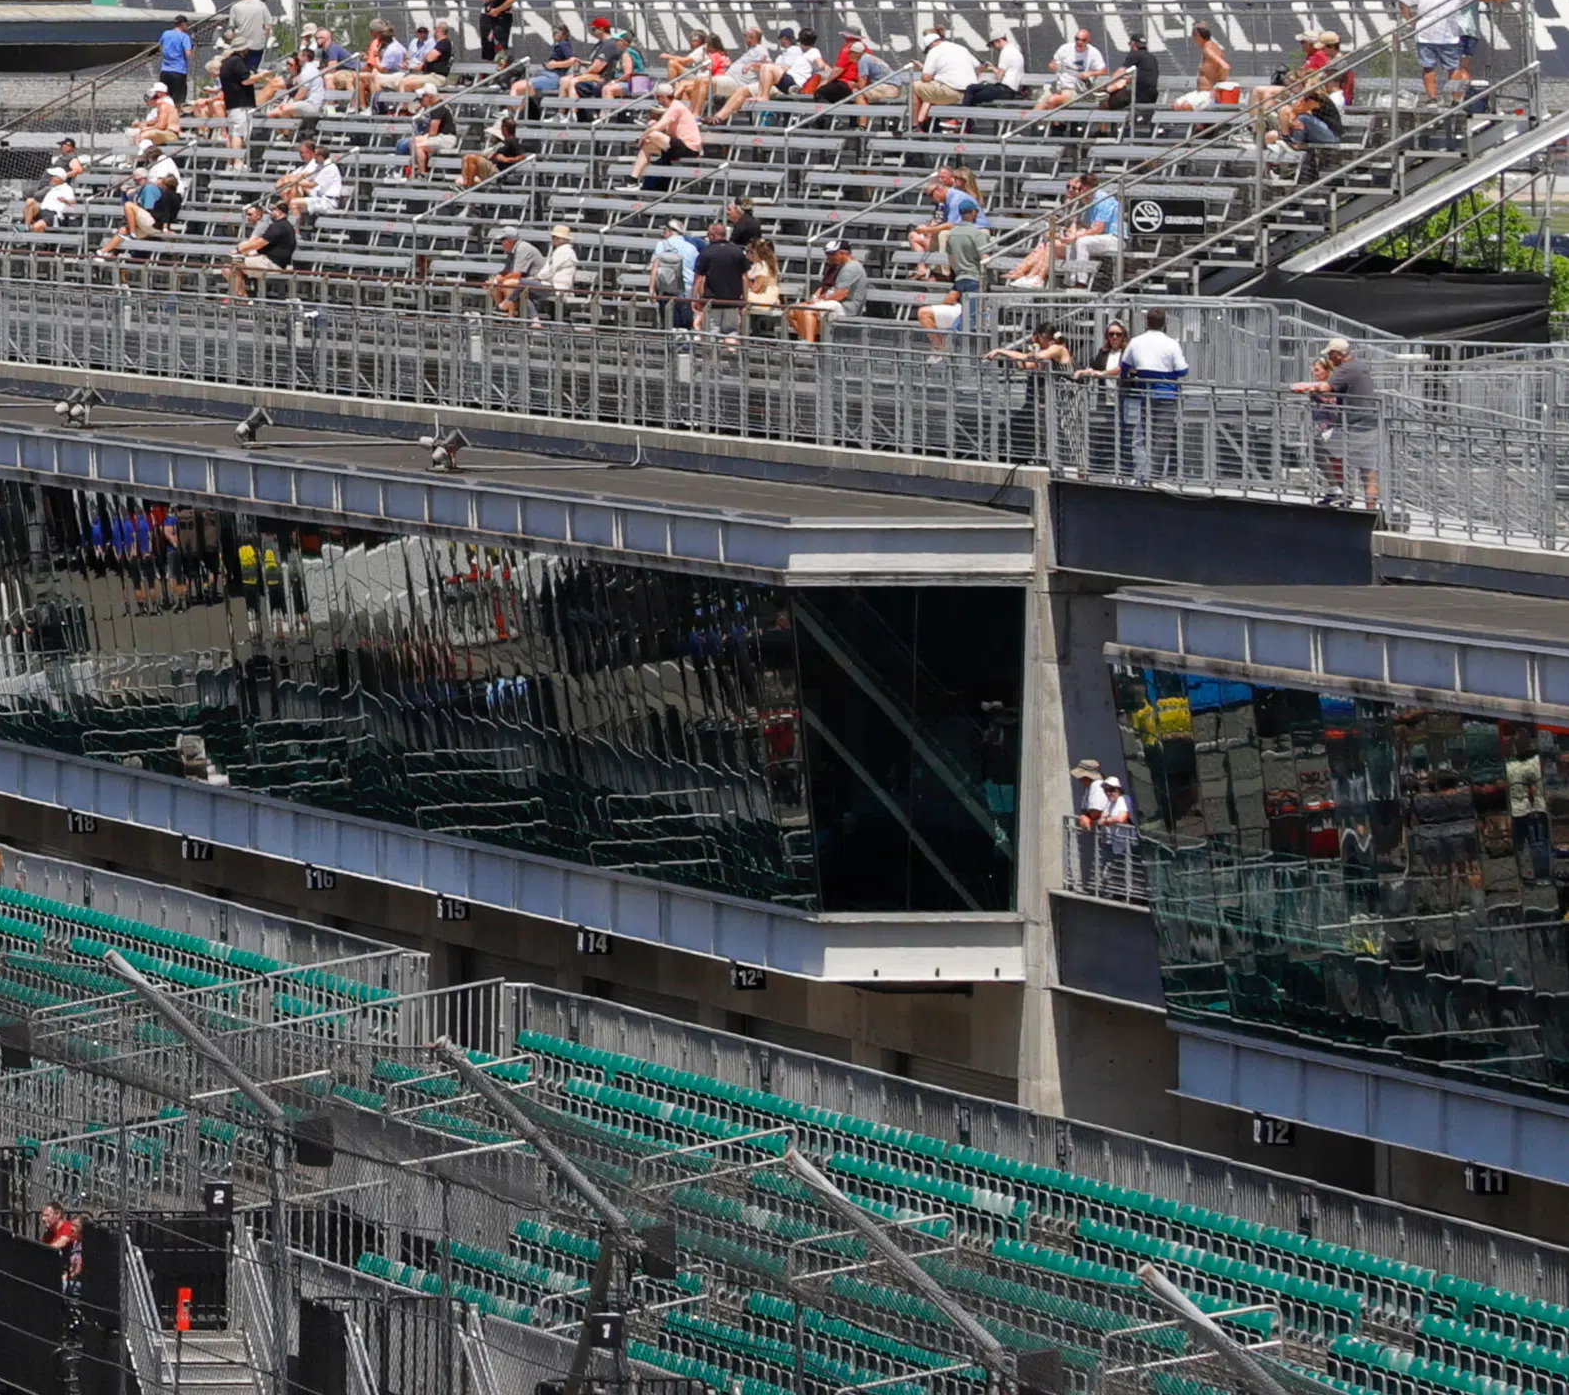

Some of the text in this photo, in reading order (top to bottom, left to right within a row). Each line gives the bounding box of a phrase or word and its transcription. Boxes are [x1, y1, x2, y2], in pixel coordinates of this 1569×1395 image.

[1266, 1122, 1290, 1144] 12
[1481, 1169, 1503, 1192] 11
[213, 1190, 224, 1204] 2
[602, 1322, 611, 1339] 1
